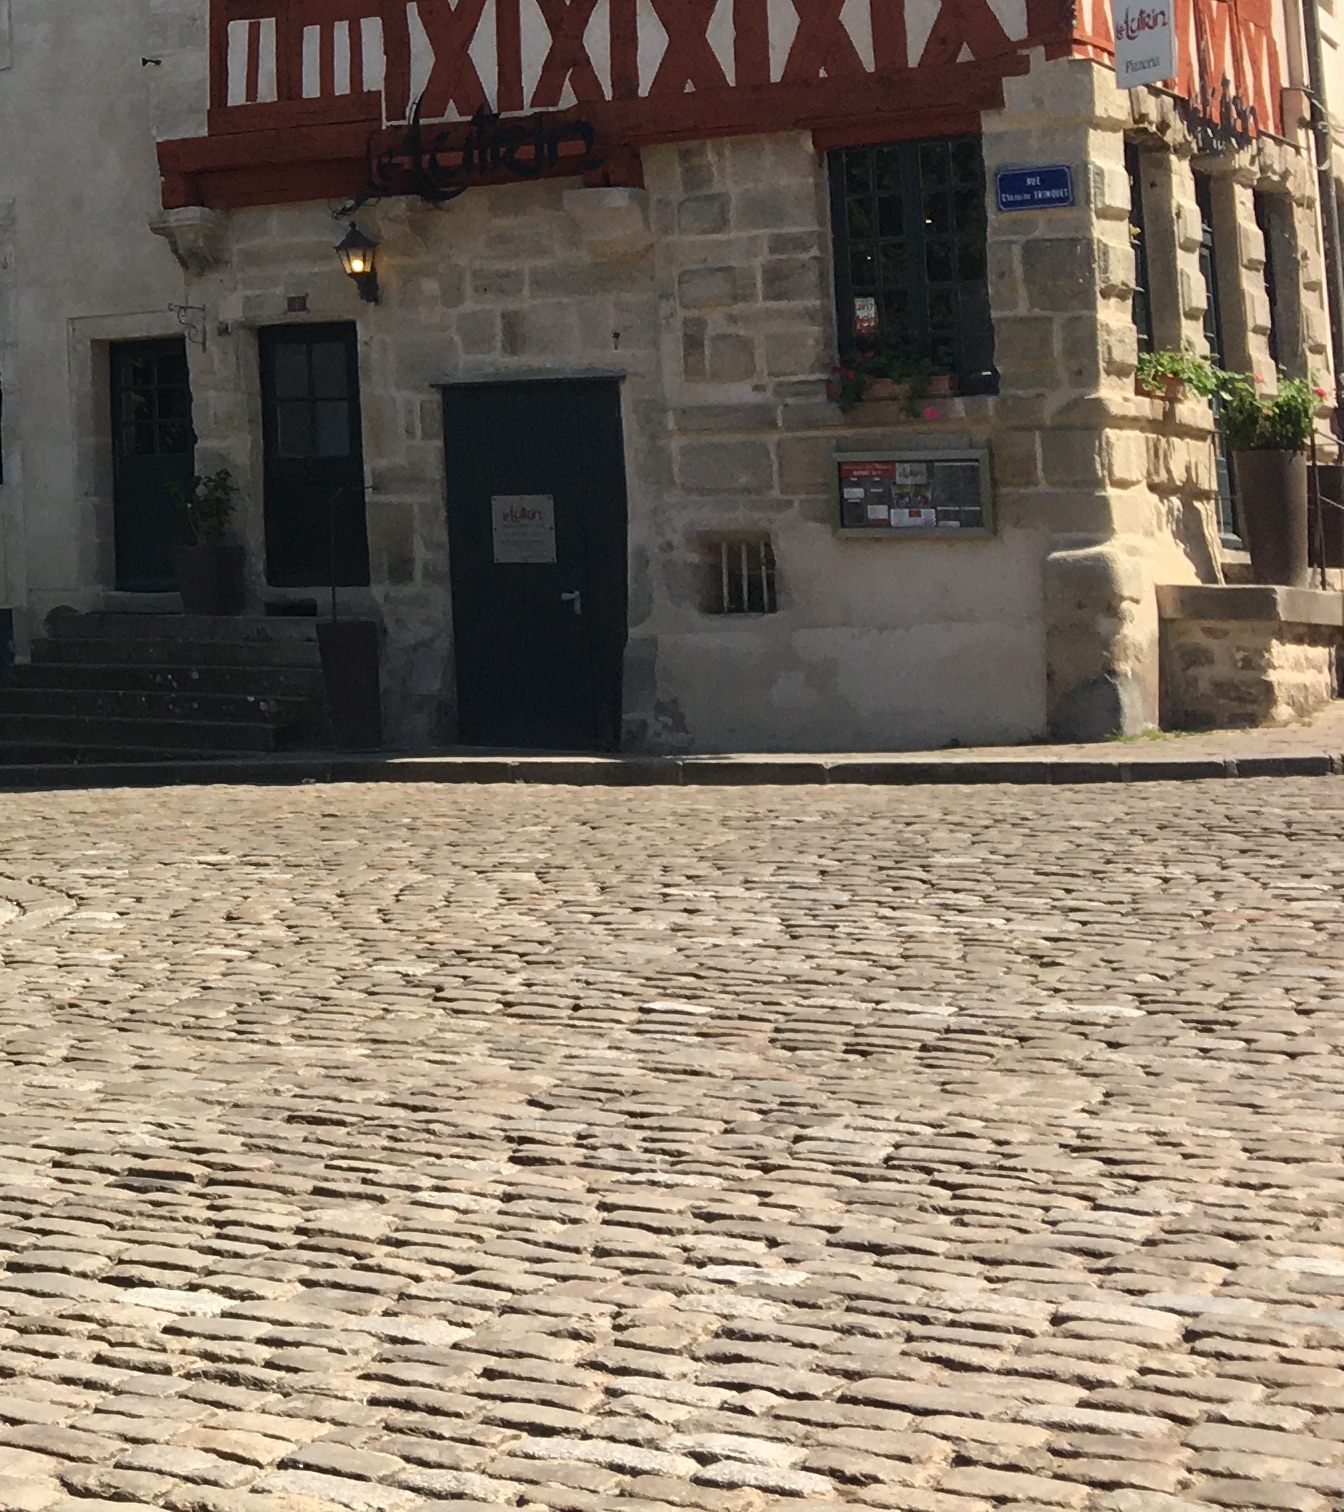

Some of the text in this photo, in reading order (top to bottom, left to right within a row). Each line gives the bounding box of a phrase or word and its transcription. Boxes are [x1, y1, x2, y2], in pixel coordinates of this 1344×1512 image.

[1125, 56, 1161, 74] Pizzeria
[1026, 177, 1042, 186] RUE
[1033, 188, 1068, 199] TRINQUET
